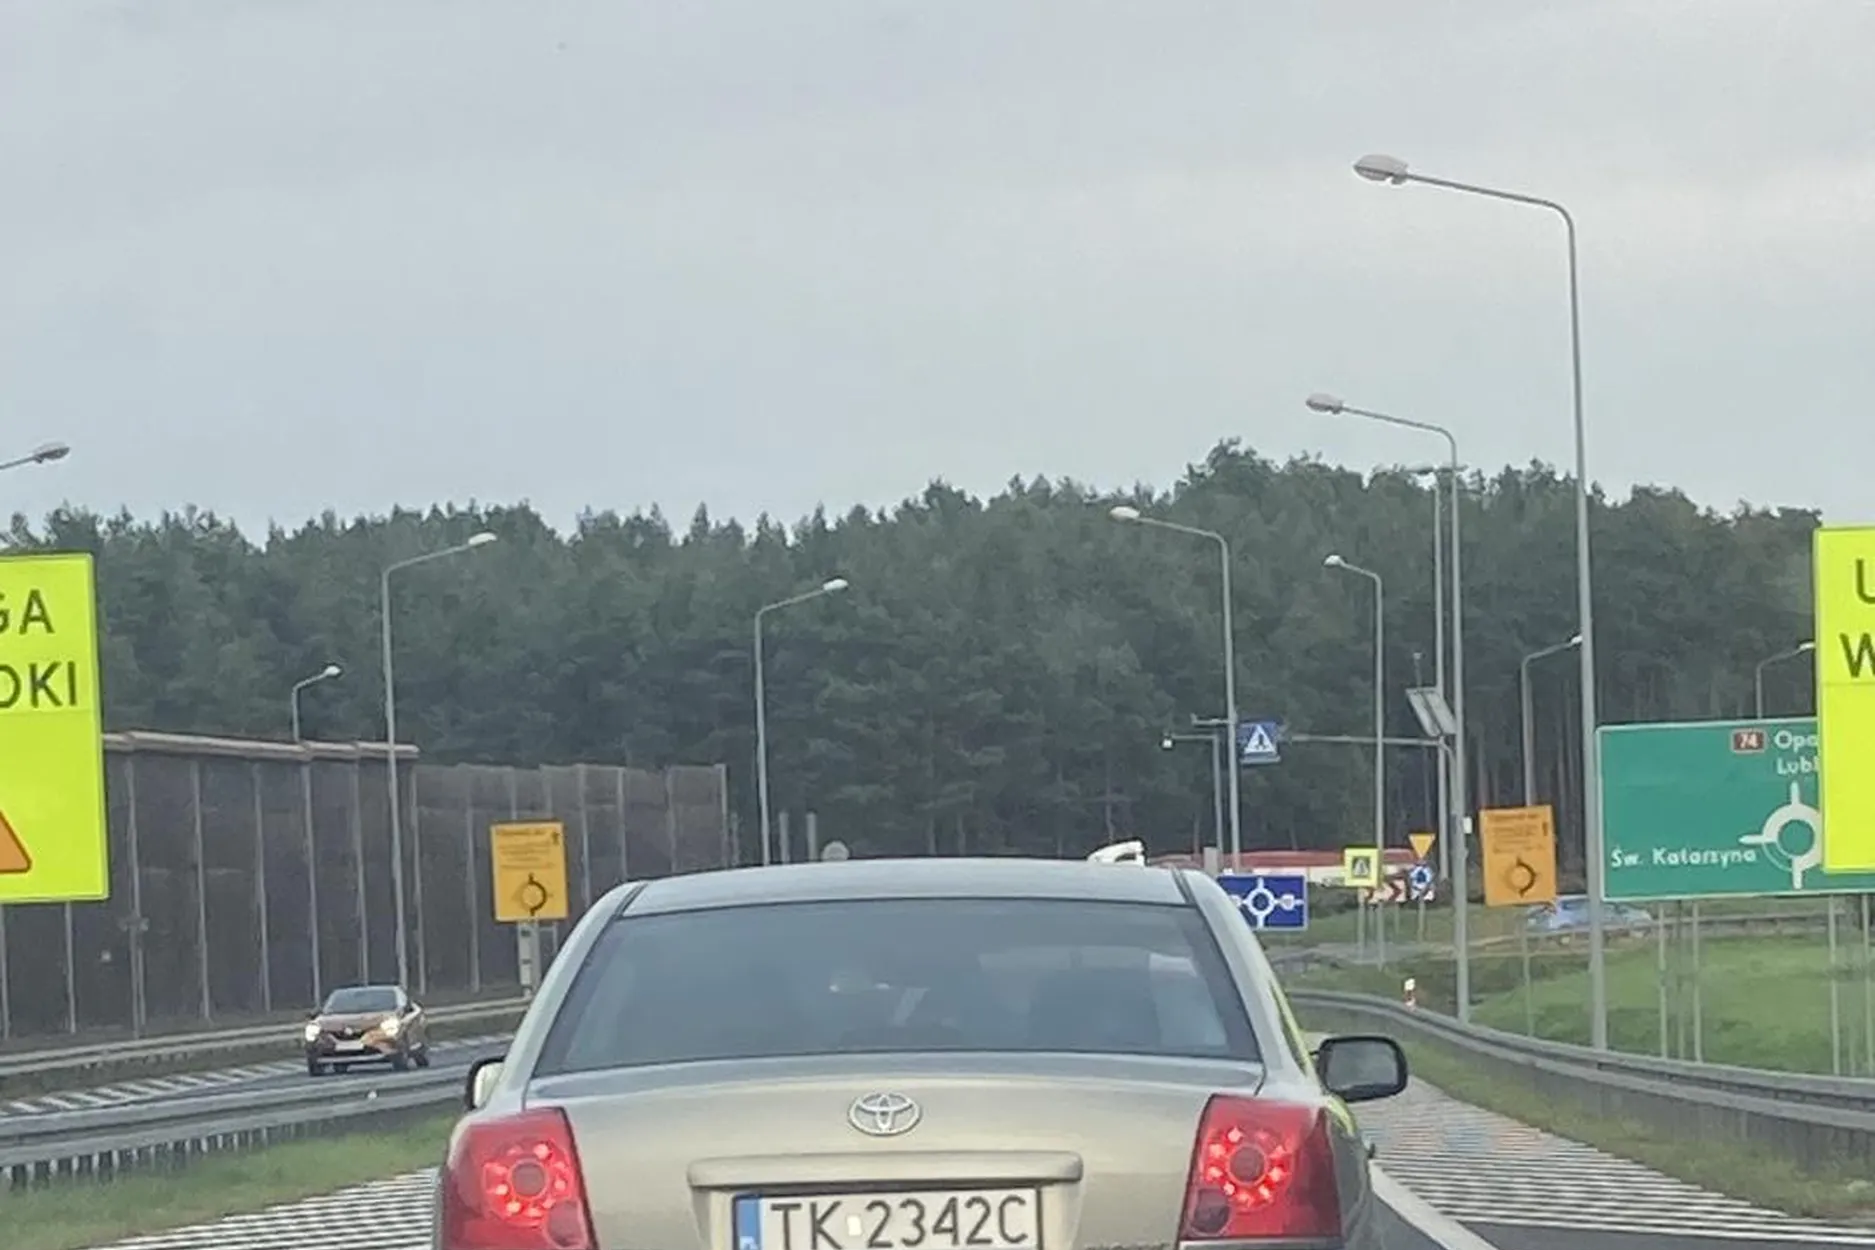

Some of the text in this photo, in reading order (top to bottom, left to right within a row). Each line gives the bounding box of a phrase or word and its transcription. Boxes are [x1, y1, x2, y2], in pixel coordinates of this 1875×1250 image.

[1740, 732, 1759, 749] 74
[1652, 847, 1757, 869] Katarzyna
[865, 1196, 1028, 1249] 2342C
